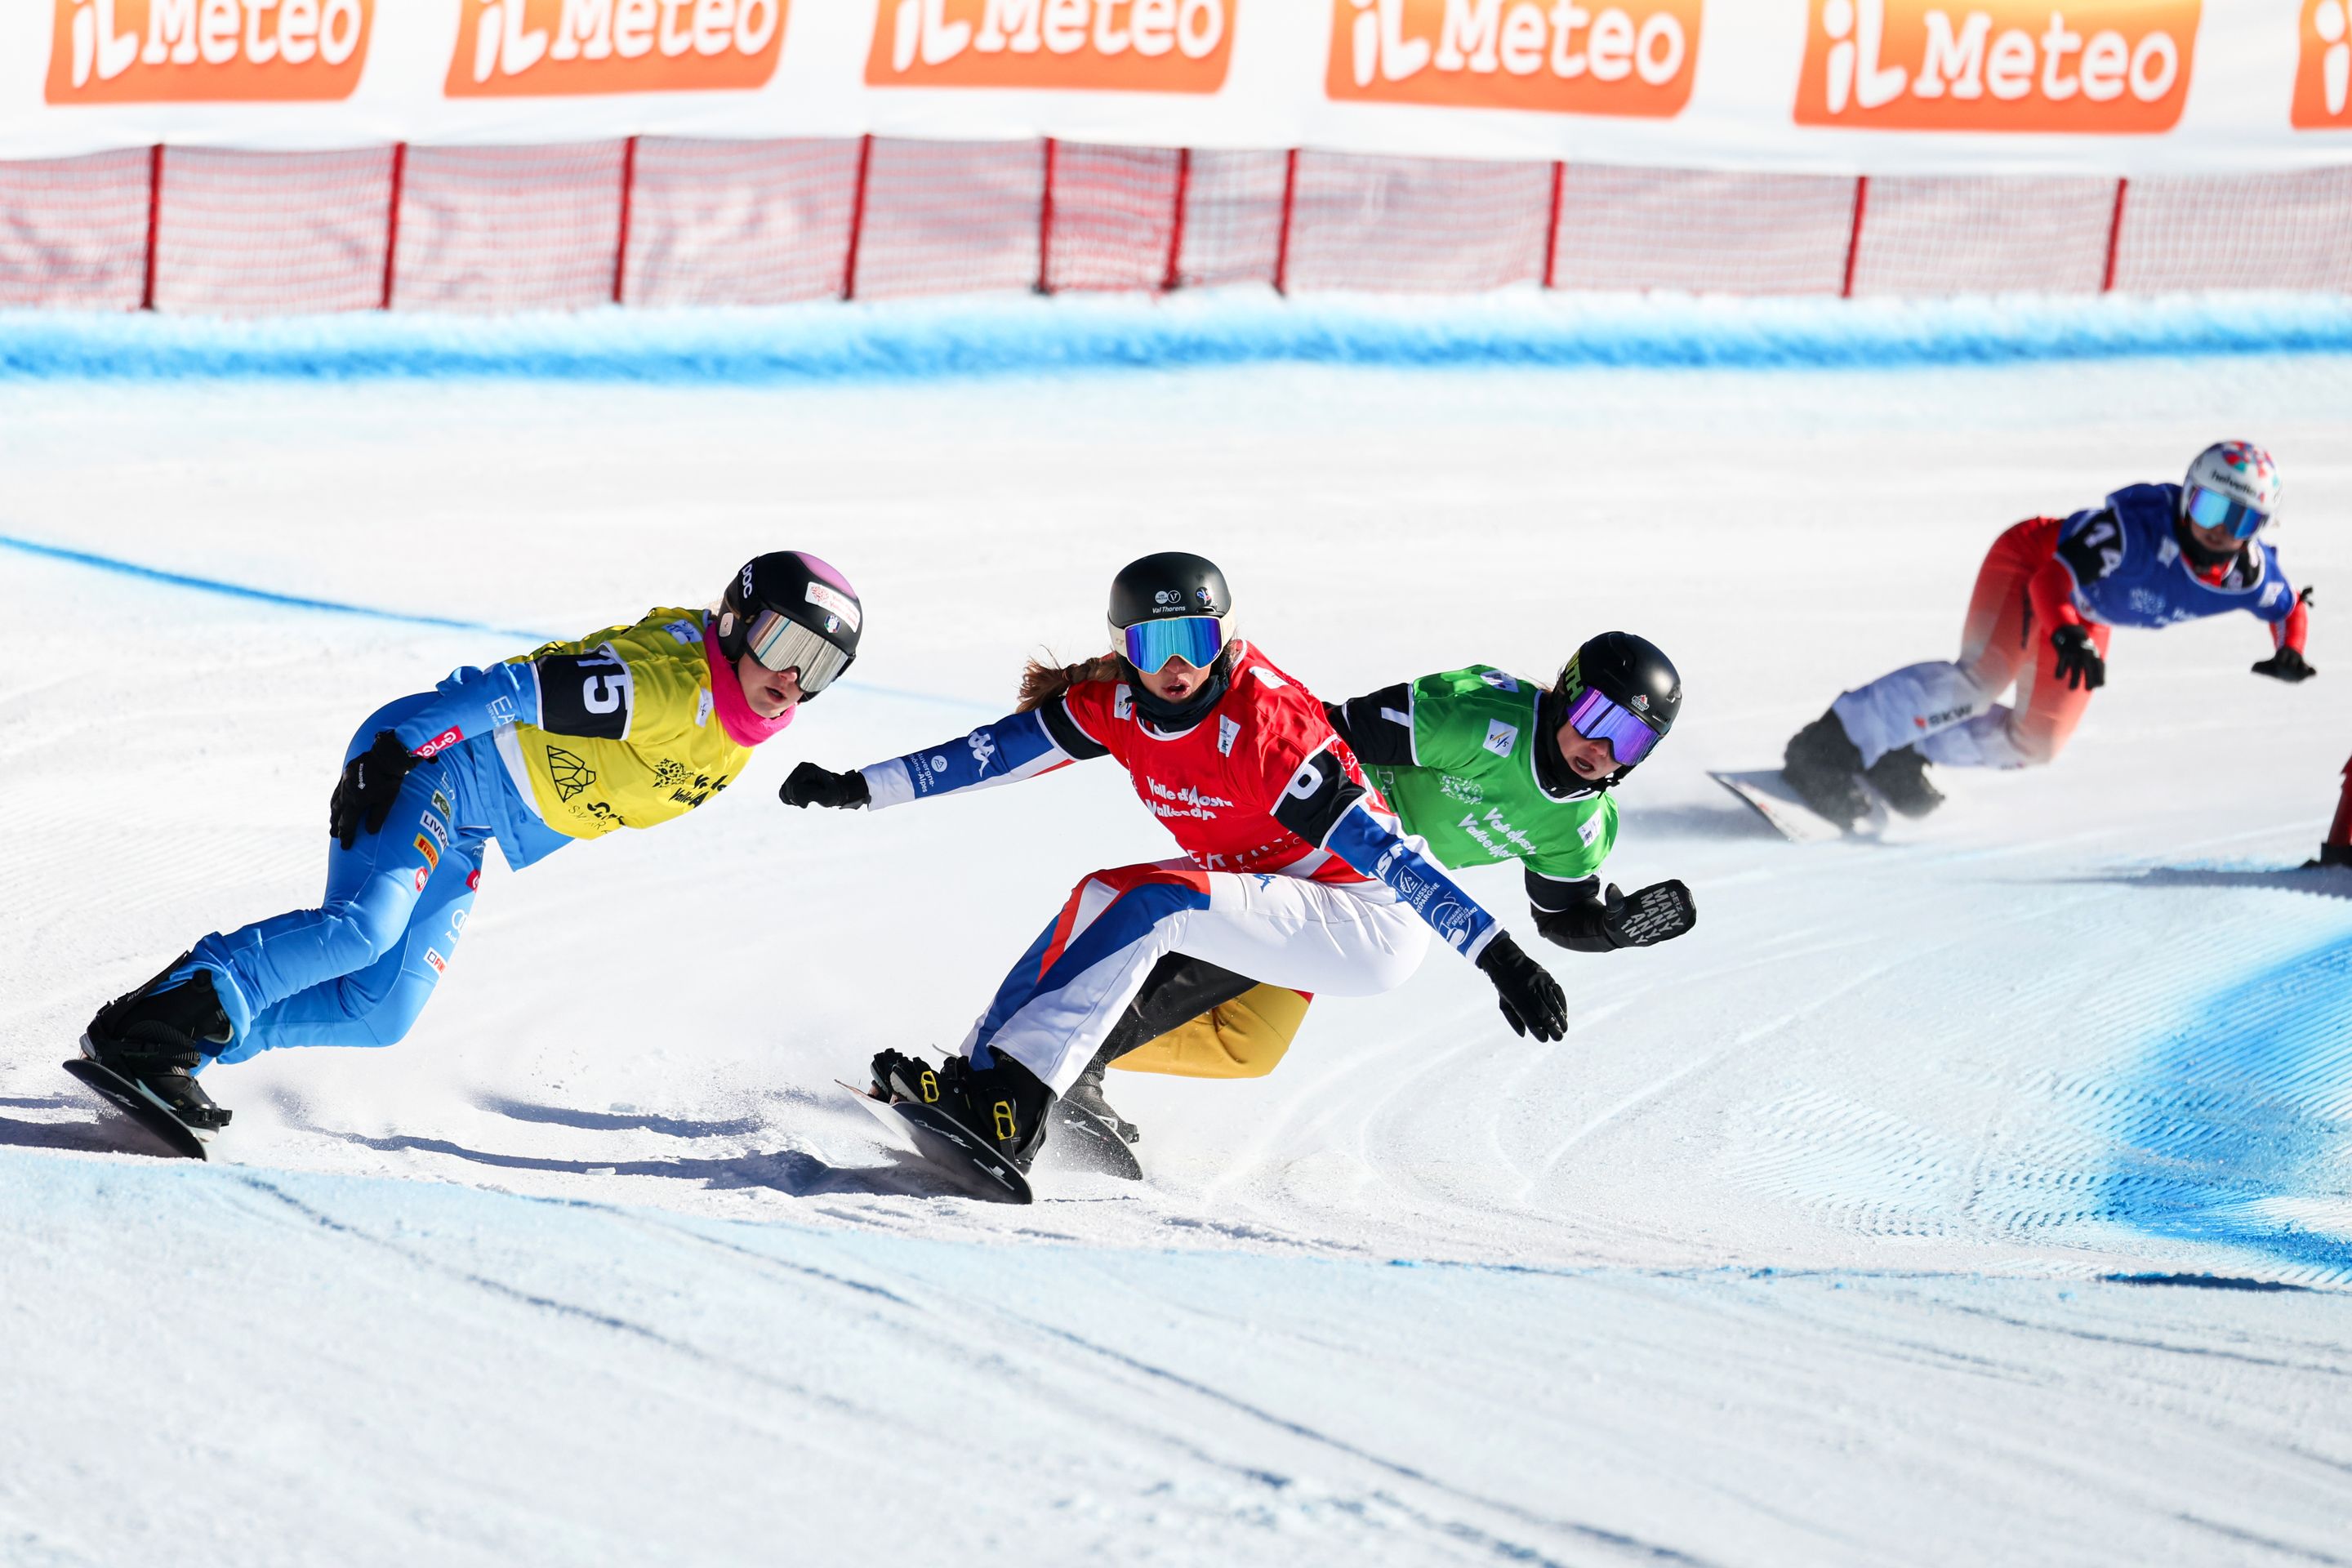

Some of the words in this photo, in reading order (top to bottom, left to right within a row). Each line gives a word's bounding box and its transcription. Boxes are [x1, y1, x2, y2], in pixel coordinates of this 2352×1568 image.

[1413, 884, 1430, 906] CAISSE
[1641, 893, 1673, 932] MANY
[1654, 887, 1684, 926] MANY
